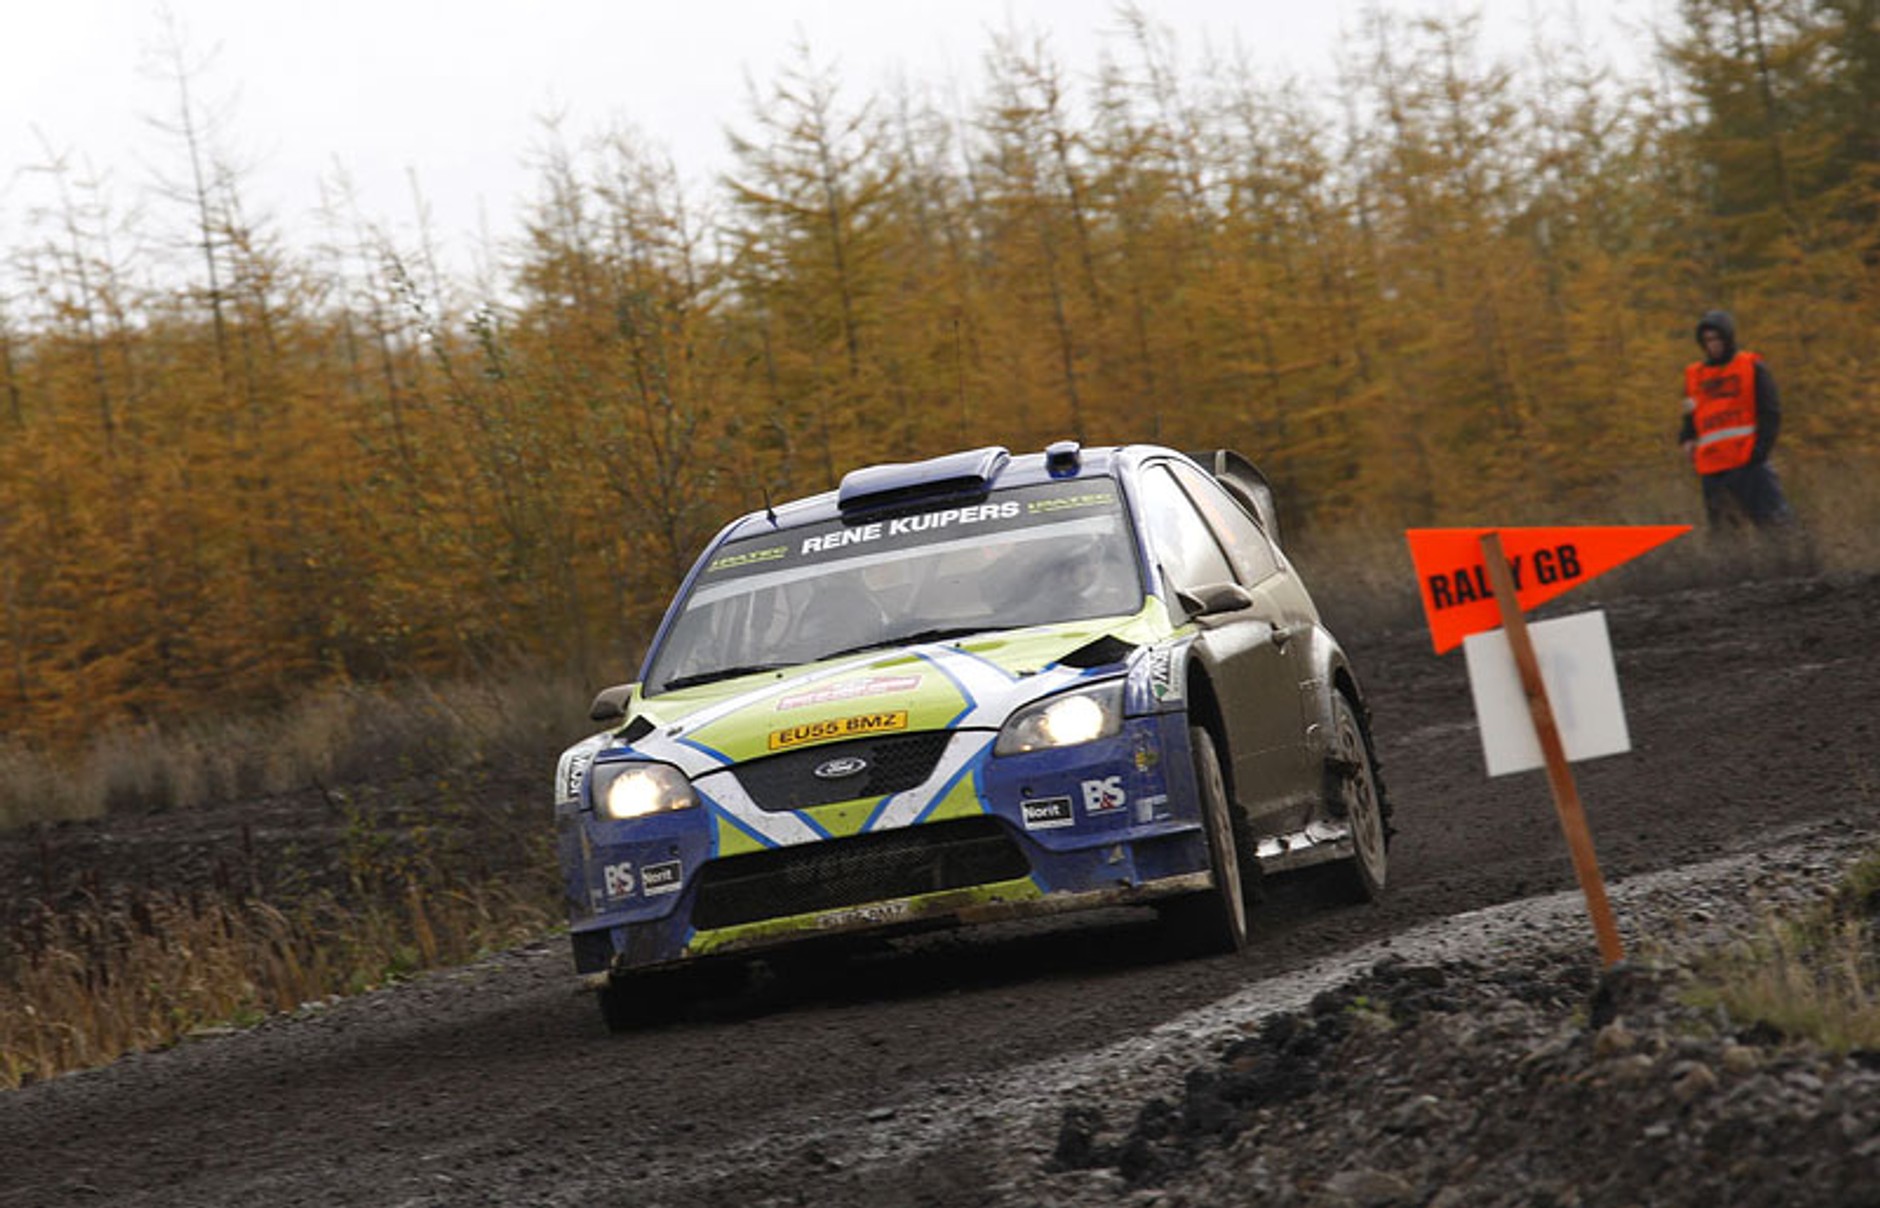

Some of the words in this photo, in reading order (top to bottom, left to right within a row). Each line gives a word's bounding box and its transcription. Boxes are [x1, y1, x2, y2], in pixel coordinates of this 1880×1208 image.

[801, 526, 882, 554] RENE
[889, 501, 1020, 535] KUIPERS
[1428, 556, 1522, 610] RALY
[1533, 544, 1581, 586] GB
[779, 721, 839, 742] EU55
[846, 714, 897, 731] BMZ
